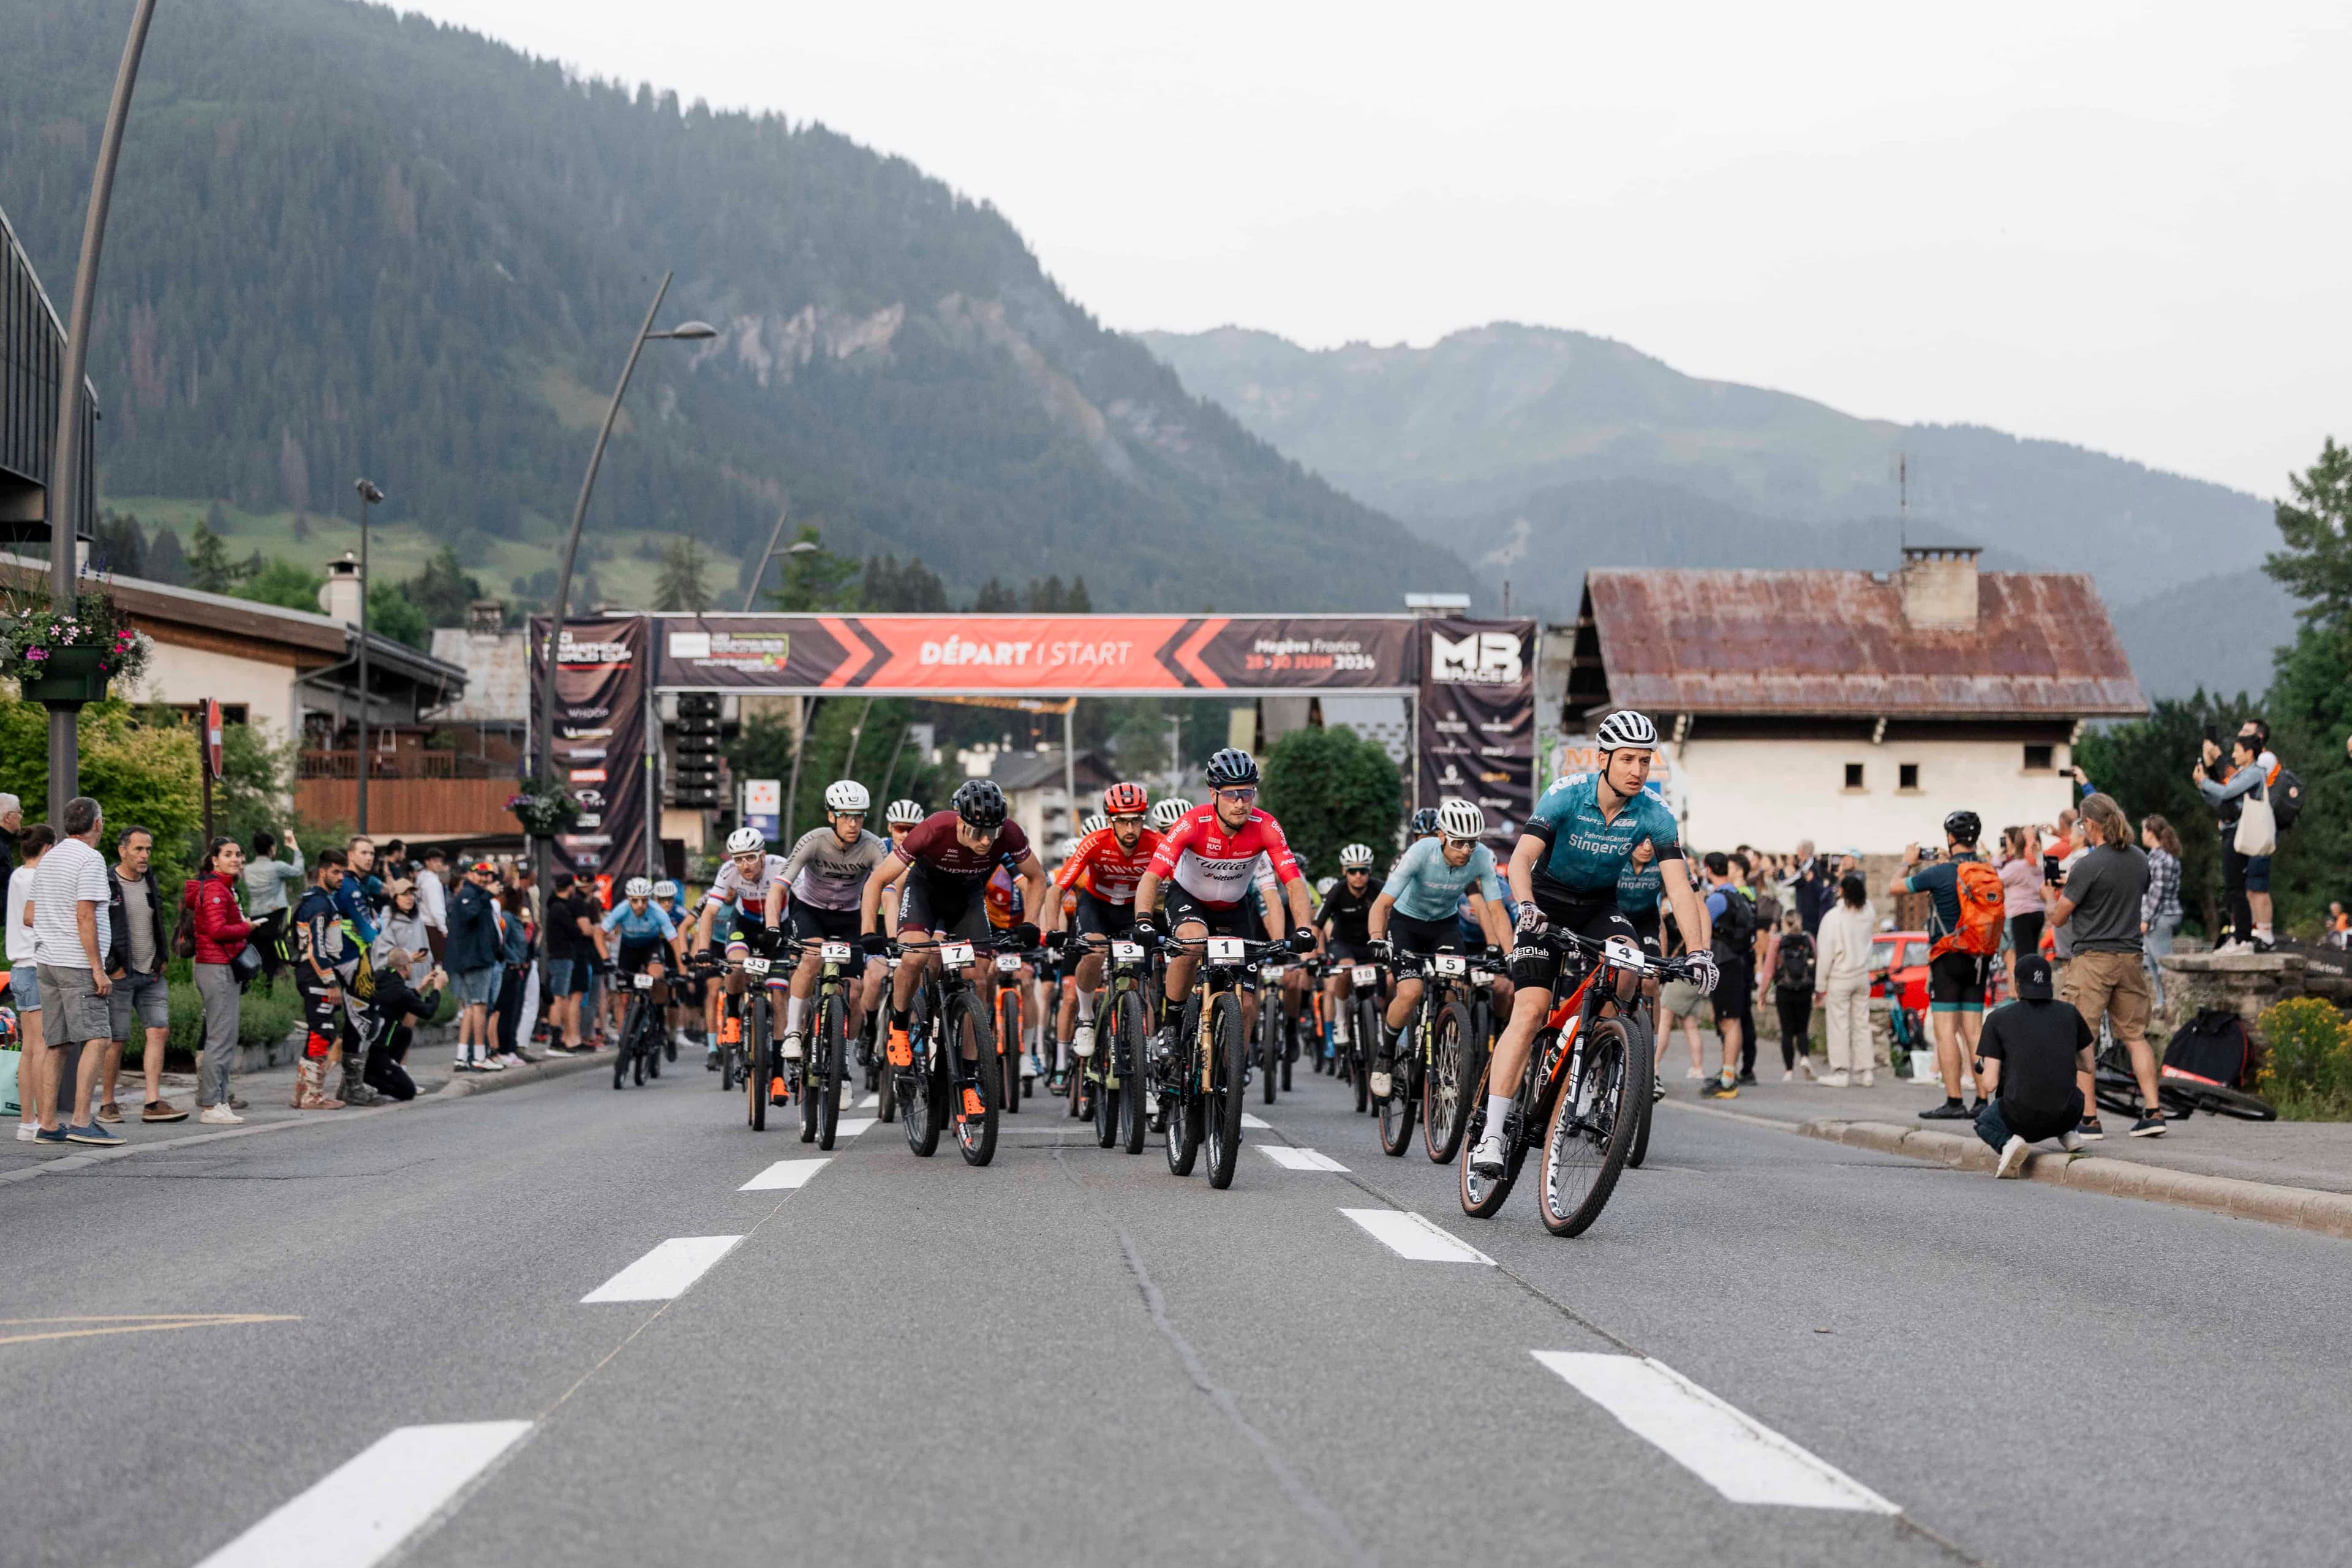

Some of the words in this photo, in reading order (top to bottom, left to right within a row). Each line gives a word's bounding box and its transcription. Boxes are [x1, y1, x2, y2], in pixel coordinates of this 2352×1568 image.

[921, 634, 1032, 666] DÉPART
[1050, 641, 1133, 666] START
[1254, 638, 1310, 656] Megève
[1312, 638, 1361, 654] France
[1334, 654, 1376, 670] 2024
[1577, 815, 1598, 824] CRAFT
[1612, 818, 1637, 827] KTM
[1584, 831, 1632, 843] FahrradCenter
[1569, 834, 1618, 855] Singer
[815, 859, 868, 871] CANYON
[1093, 862, 1147, 874] CANYO
[1618, 880, 1649, 889] inger
[951, 947, 962, 959] 7
[1123, 945, 1133, 954] 3
[1221, 941, 1229, 954] 1
[1618, 947, 1632, 959] 4
[748, 959, 766, 968] 33
[1446, 959, 1456, 970] 5
